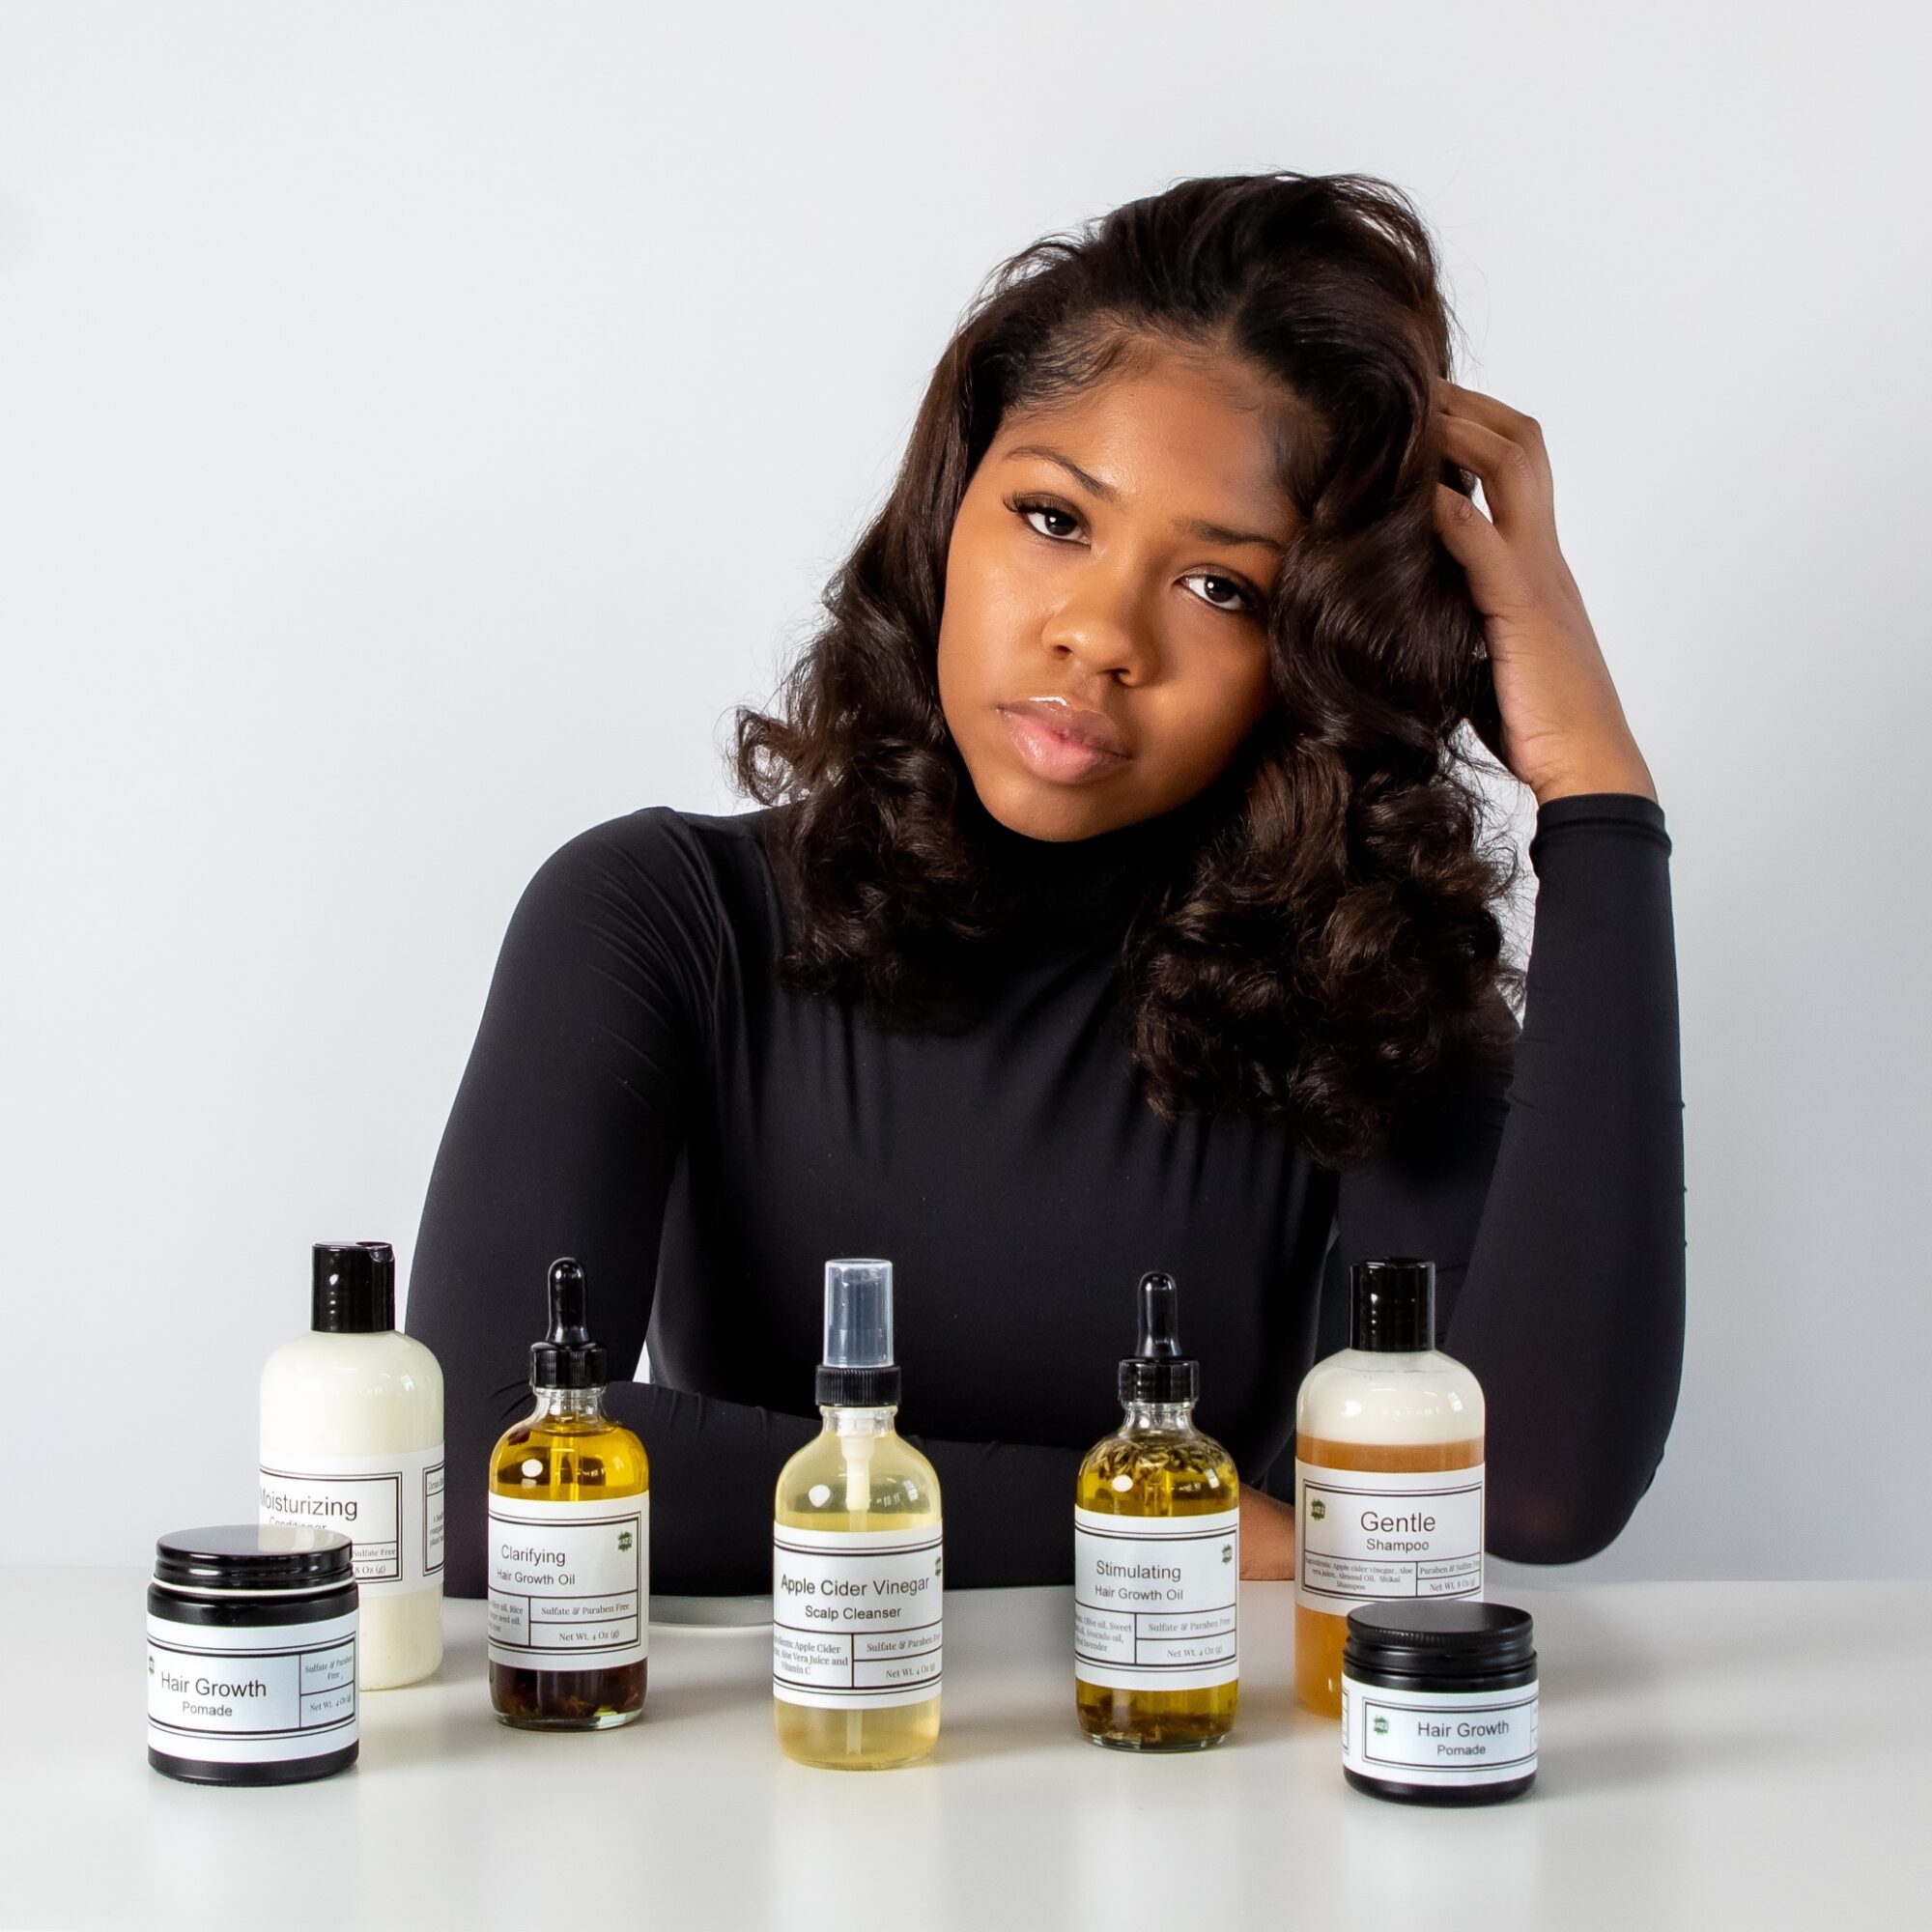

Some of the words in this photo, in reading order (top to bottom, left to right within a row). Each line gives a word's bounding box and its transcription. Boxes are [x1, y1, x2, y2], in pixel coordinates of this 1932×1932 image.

[1360, 1511, 1435, 1533] Gentle
[381, 1548, 396, 1556] Free
[1366, 1538, 1430, 1553] Shampoo
[501, 1544, 566, 1568] Clarifying
[497, 1568, 512, 1581] Hair
[514, 1572, 554, 1585] Growth
[558, 1574, 576, 1585] Oil
[1096, 1560, 1181, 1582] Stimulating
[781, 1574, 815, 1597] Apple
[820, 1579, 867, 1596] Cider
[873, 1577, 929, 1596] Vinegar
[1094, 1584, 1115, 1598] Hair
[1118, 1588, 1162, 1601] Growth
[1166, 1589, 1183, 1601] Oil
[541, 1606, 570, 1616] Sulfate
[582, 1605, 614, 1614] Paraben
[805, 1605, 839, 1622] Scalp
[842, 1607, 901, 1620] Cleanser
[1109, 1622, 1132, 1633] Sweet
[1149, 1622, 1178, 1633] Sulfate
[1190, 1619, 1219, 1630] Paraben
[558, 1633, 574, 1641] Net
[598, 1631, 610, 1639] Oz
[795, 1641, 815, 1653] Apple
[817, 1644, 841, 1654] Cider
[867, 1641, 896, 1652] Sulfate
[1167, 1649, 1181, 1658] Net
[809, 1655, 830, 1665] Juice
[832, 1657, 849, 1666] and
[304, 1662, 328, 1673] Sulfate
[886, 1669, 900, 1679] Net
[161, 1670, 190, 1693] Hair
[195, 1677, 267, 1697] Growth
[183, 1700, 233, 1717] Pomade
[309, 1702, 322, 1712] Net
[1417, 1721, 1451, 1737] Hair
[1457, 1719, 1510, 1737] Growth
[1436, 1744, 1487, 1756] Pomade
